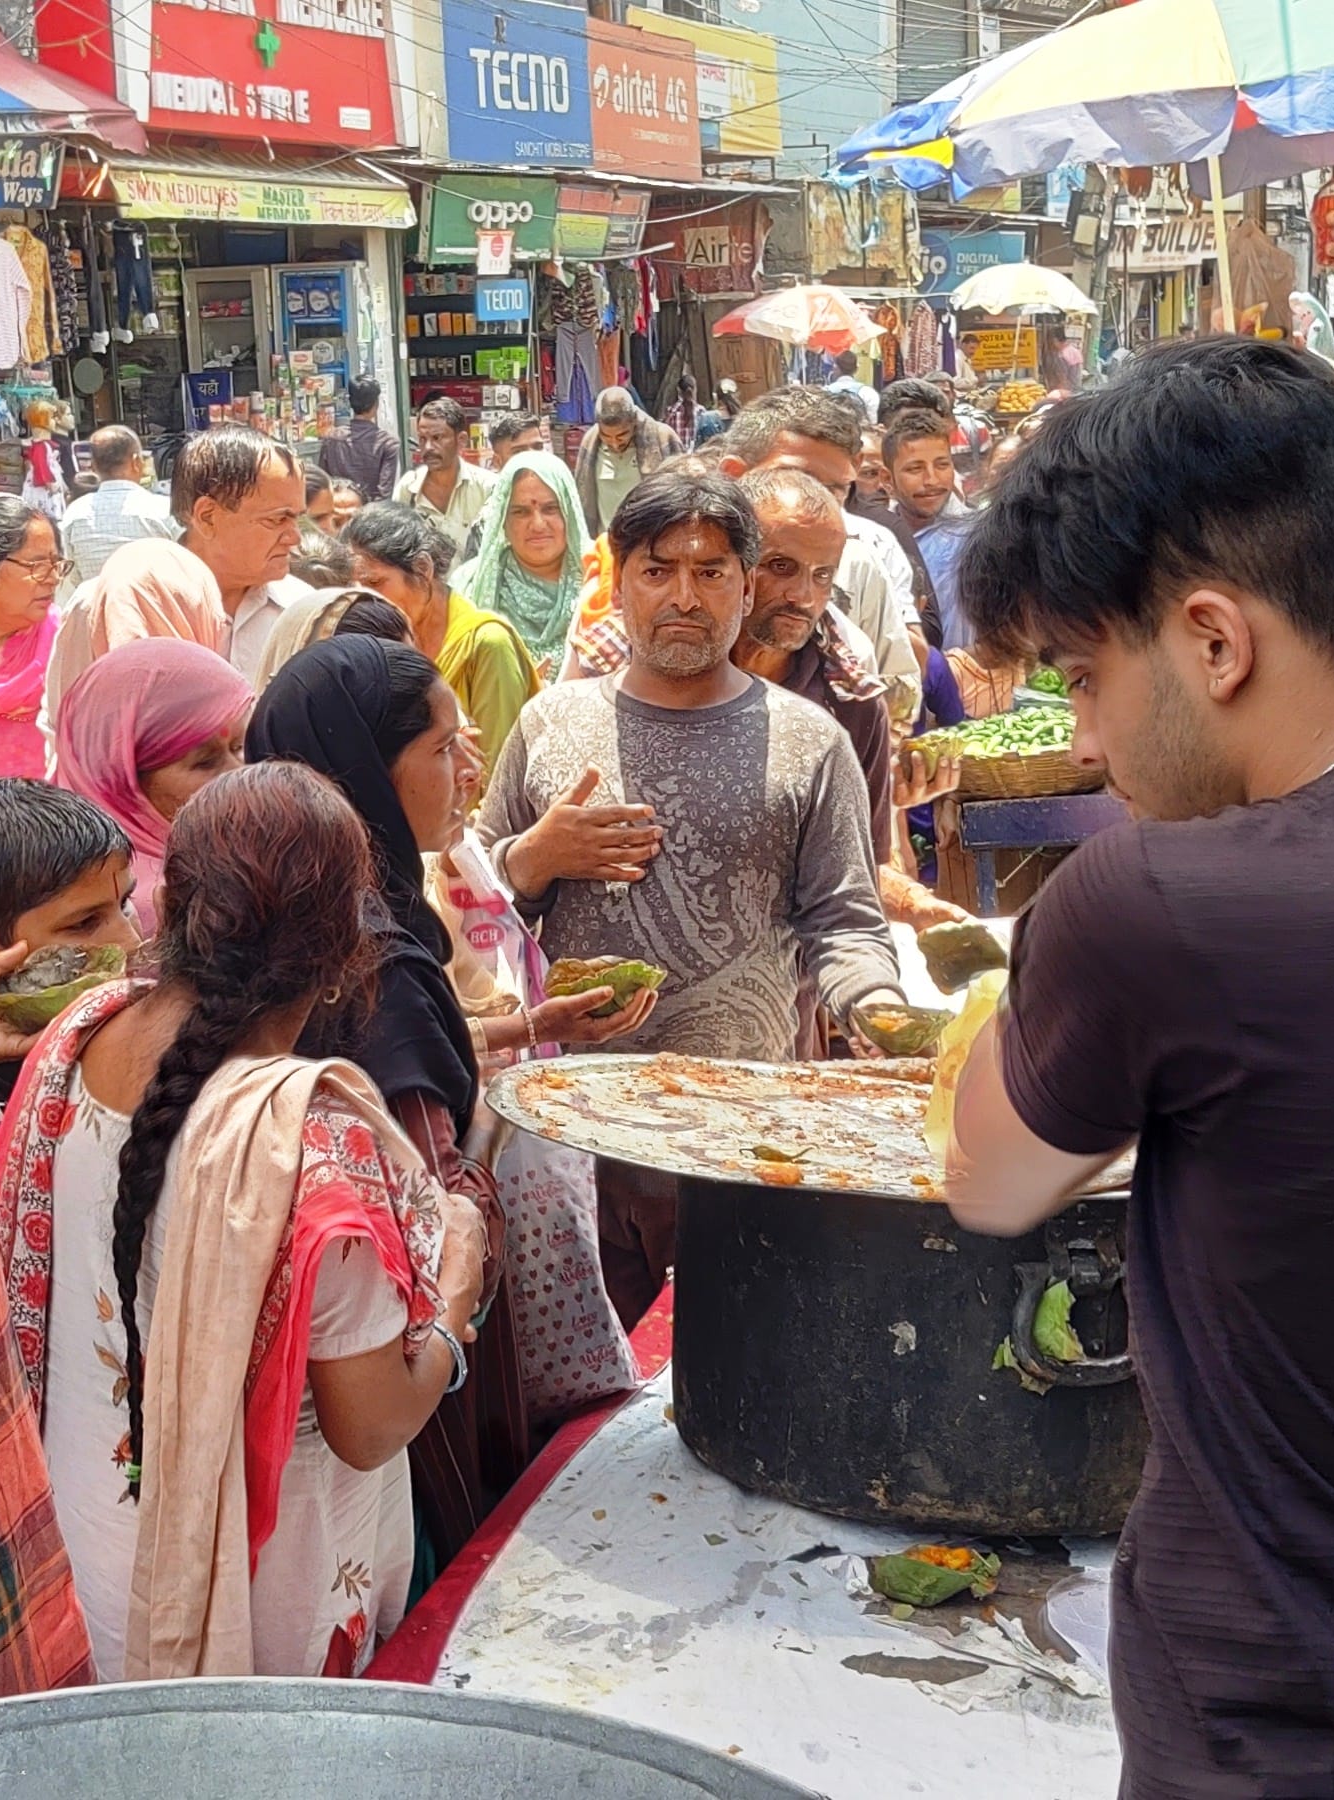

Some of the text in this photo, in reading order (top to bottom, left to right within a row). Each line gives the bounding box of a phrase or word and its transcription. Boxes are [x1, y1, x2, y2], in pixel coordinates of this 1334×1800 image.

[469, 48, 569, 113] TECNO
[613, 63, 688, 124] airtel 4G
[152, 71, 240, 117] MEDICAL
[246, 84, 311, 123] STORE
[545, 143, 567, 158] MOBILE
[3, 181, 44, 208] Ways
[469, 201, 533, 229] oppo
[690, 236, 753, 263] Airte
[919, 247, 1000, 275] io DIGITAL
[483, 289, 523, 311] TECNO
[470, 929, 498, 943] BCH
